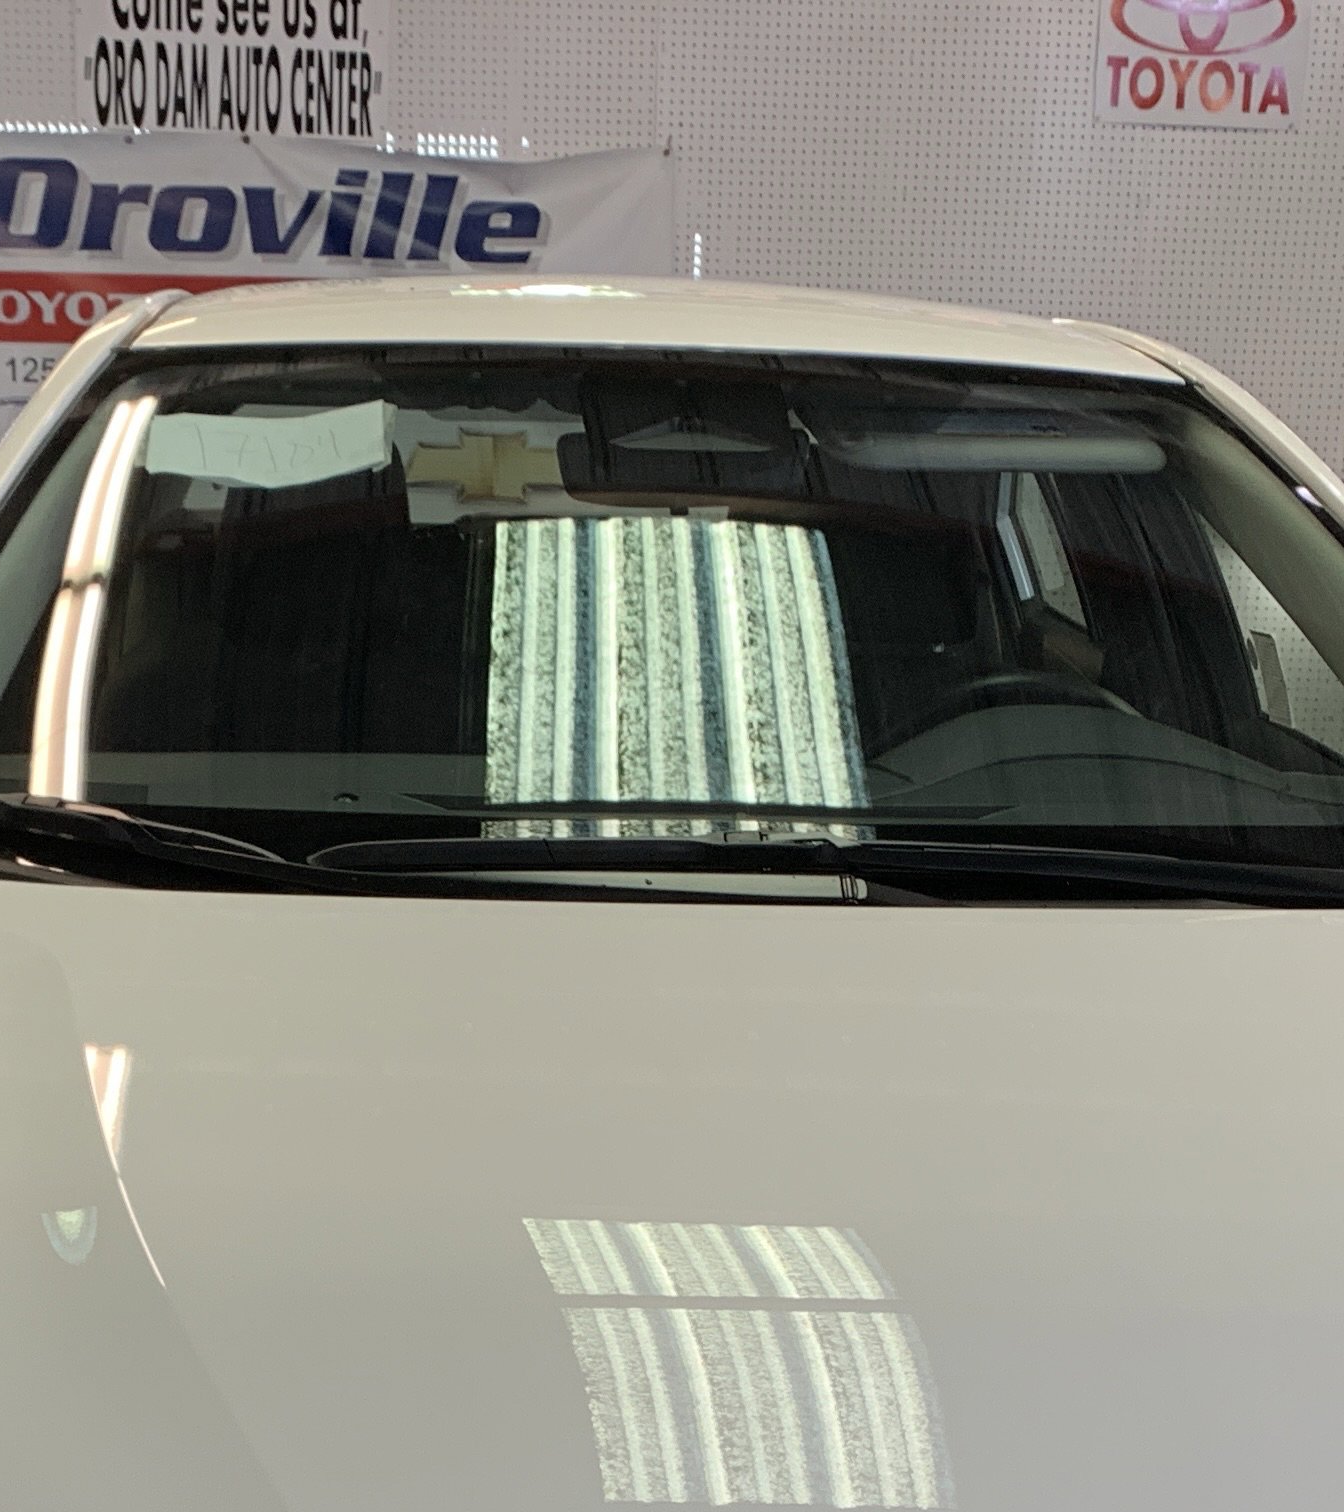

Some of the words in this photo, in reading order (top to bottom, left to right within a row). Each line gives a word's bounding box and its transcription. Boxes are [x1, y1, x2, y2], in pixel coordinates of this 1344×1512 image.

[216, 0, 270, 37] see
[283, 0, 317, 39] us
[156, 41, 209, 130] DAM
[218, 44, 281, 135] AUTO
[1107, 55, 1290, 115] TOYOTA
